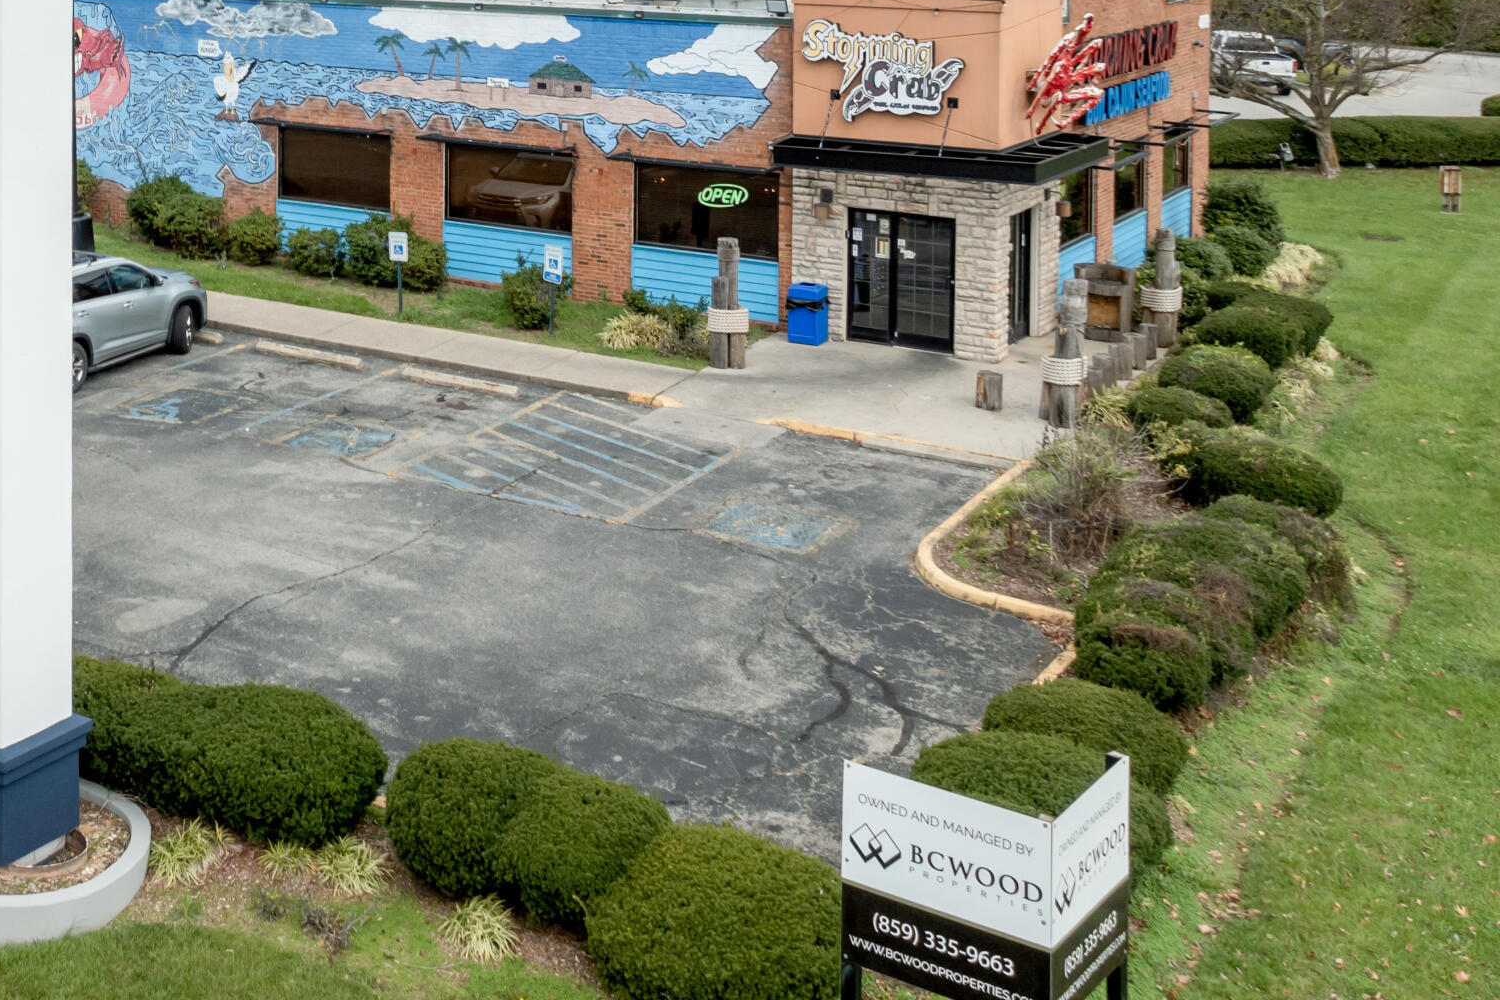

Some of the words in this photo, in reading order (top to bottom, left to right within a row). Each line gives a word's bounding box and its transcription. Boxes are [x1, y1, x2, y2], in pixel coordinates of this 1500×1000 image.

[803, 21, 933, 86] Storming
[864, 60, 942, 101] Crab
[702, 187, 743, 205] OPEN
[858, 793, 908, 818] OWNED
[911, 811, 940, 828] AND
[943, 820, 1012, 851] MANAGED
[1016, 842, 1034, 857] BY
[1078, 822, 1126, 881] BCWOOD
[909, 866, 1044, 917] PROPERTIES
[910, 843, 1043, 903] BCWOOD
[849, 934, 1034, 1000] WWW.BCWOODPROPERTIES.C
[873, 912, 919, 946] (859)
[924, 930, 1016, 977] 335-9663
[1064, 943, 1083, 979] (859)
[1084, 910, 1118, 957] 335-9663
